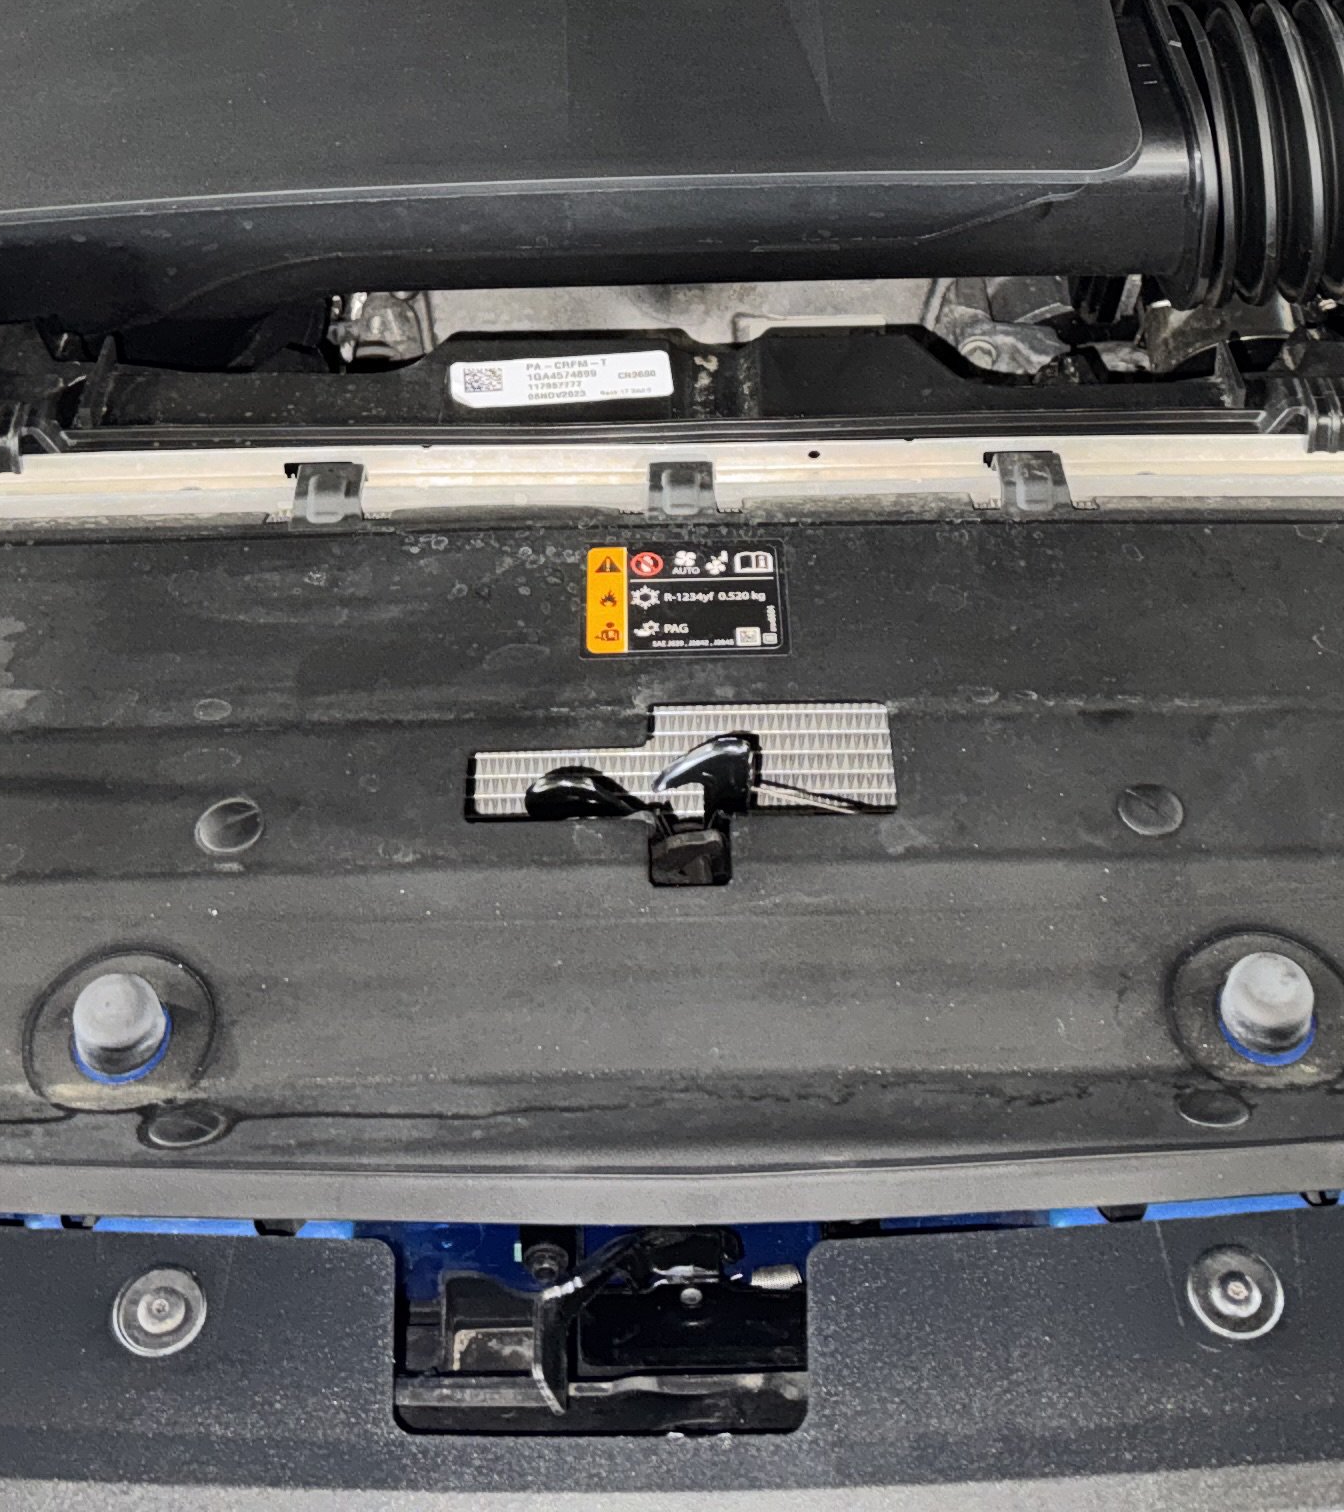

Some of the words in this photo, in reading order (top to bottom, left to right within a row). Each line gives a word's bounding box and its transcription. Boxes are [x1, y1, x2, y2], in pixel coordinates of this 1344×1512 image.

[672, 566, 701, 575] AUTO
[663, 591, 715, 603] R-1234yf
[717, 591, 749, 601] 0.520
[751, 590, 766, 602] kg
[663, 623, 689, 634] PAG
